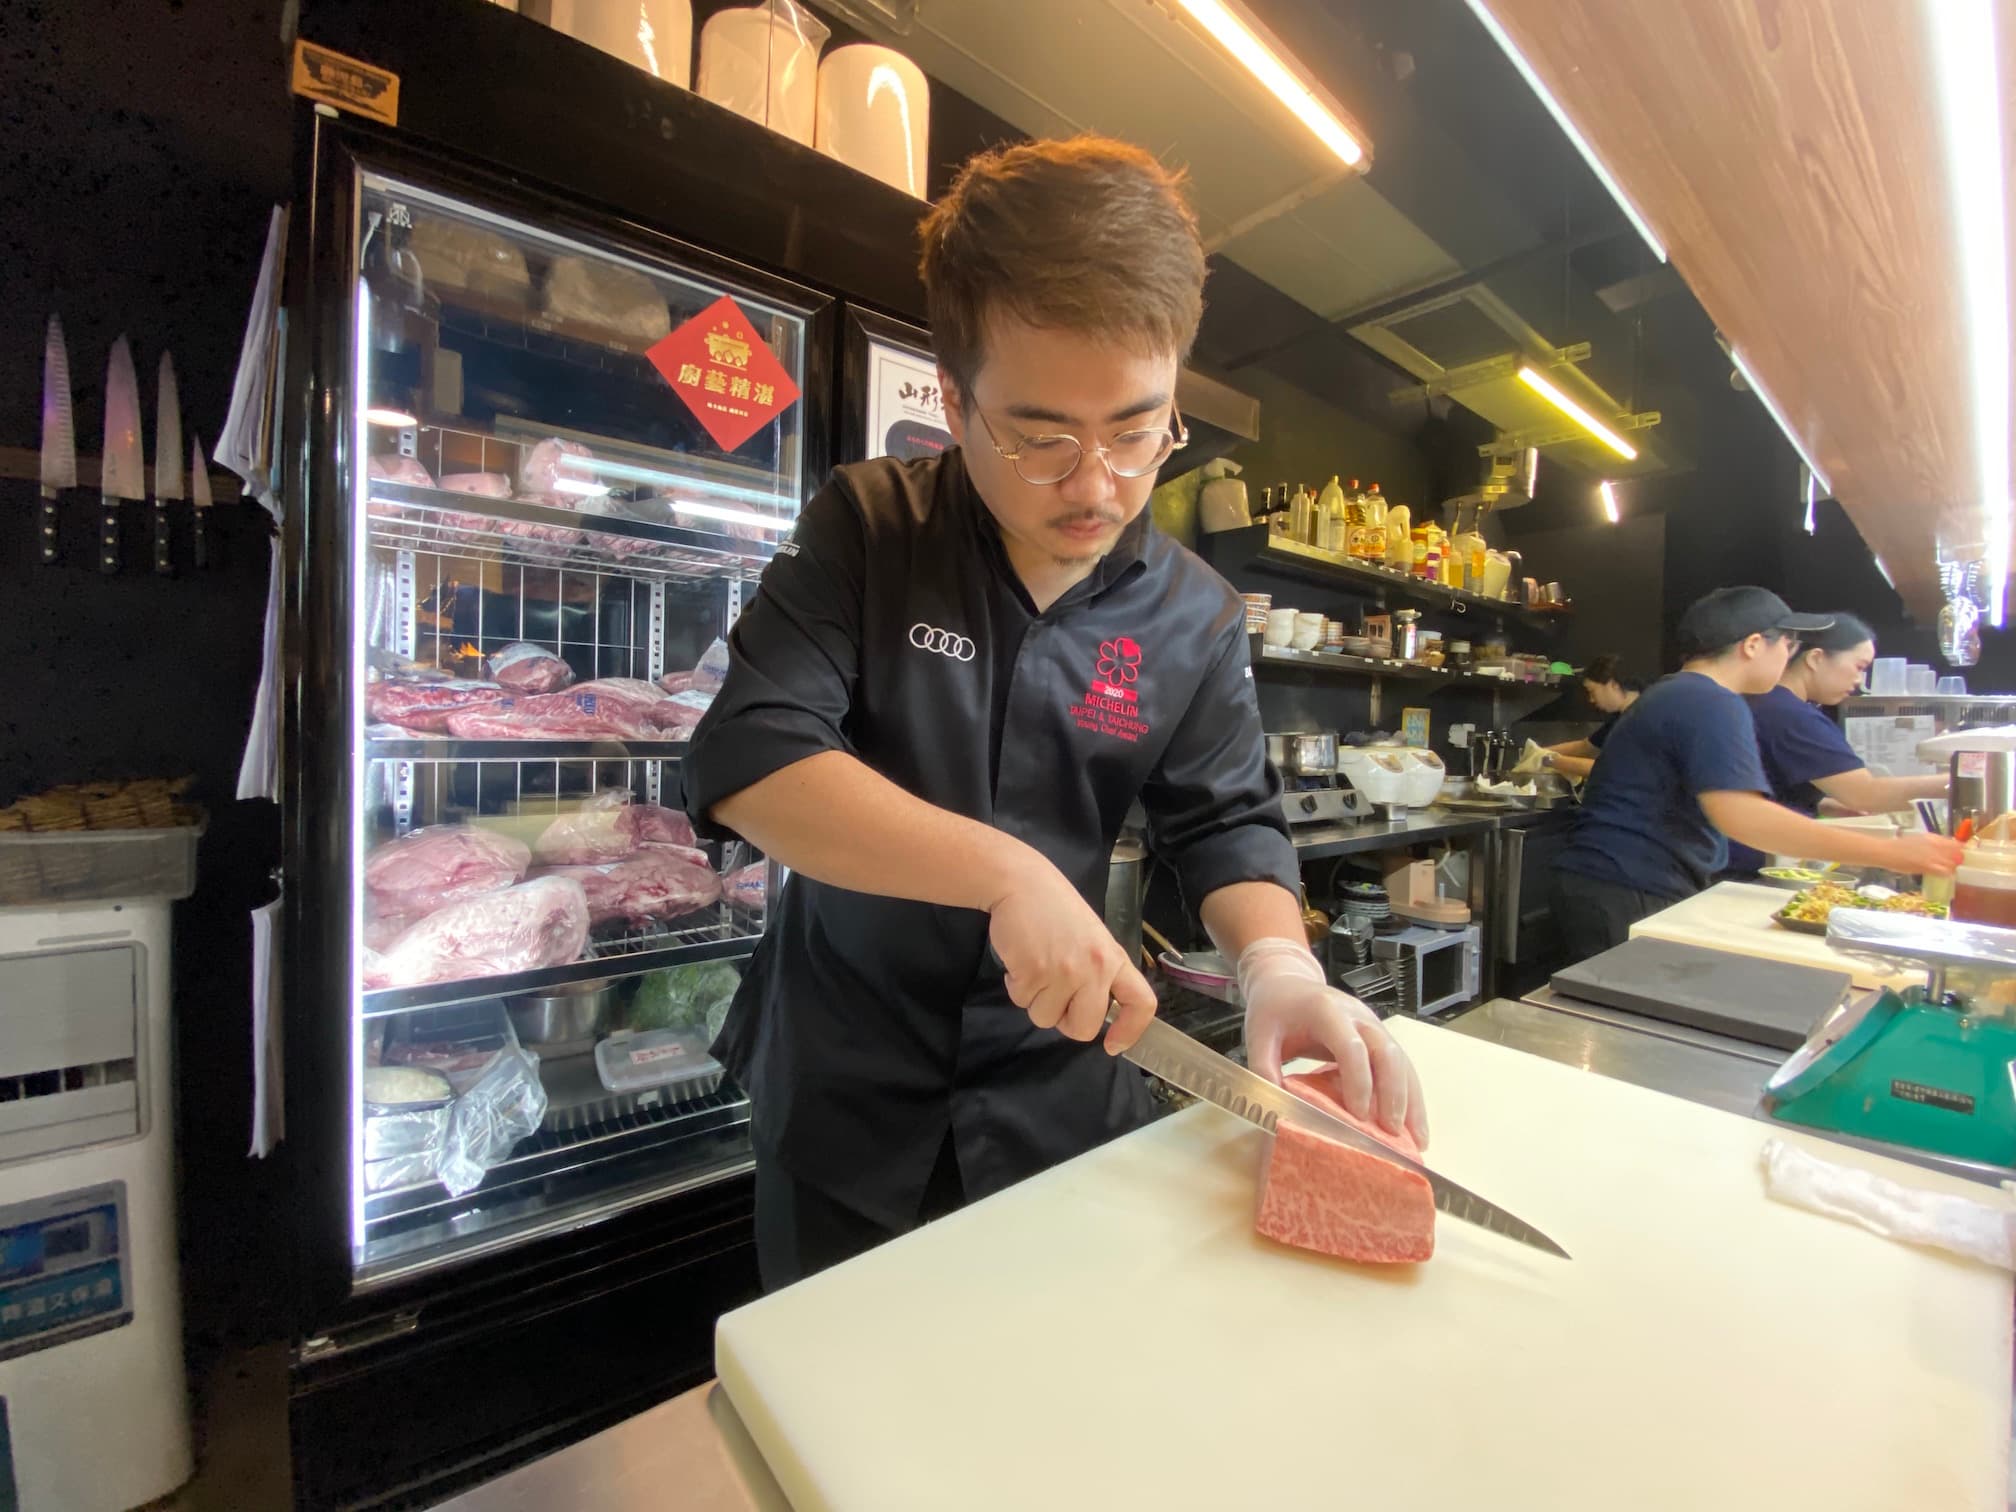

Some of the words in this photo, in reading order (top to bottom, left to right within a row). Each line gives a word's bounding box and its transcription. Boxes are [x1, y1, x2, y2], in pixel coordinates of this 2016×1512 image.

[898, 381, 944, 412] 山形
[1085, 692, 1138, 717] MICHELIN
[1104, 685, 1124, 699] 2020
[1070, 705, 1096, 719] TAIPEI
[1109, 714, 1149, 735] TAICHUNG
